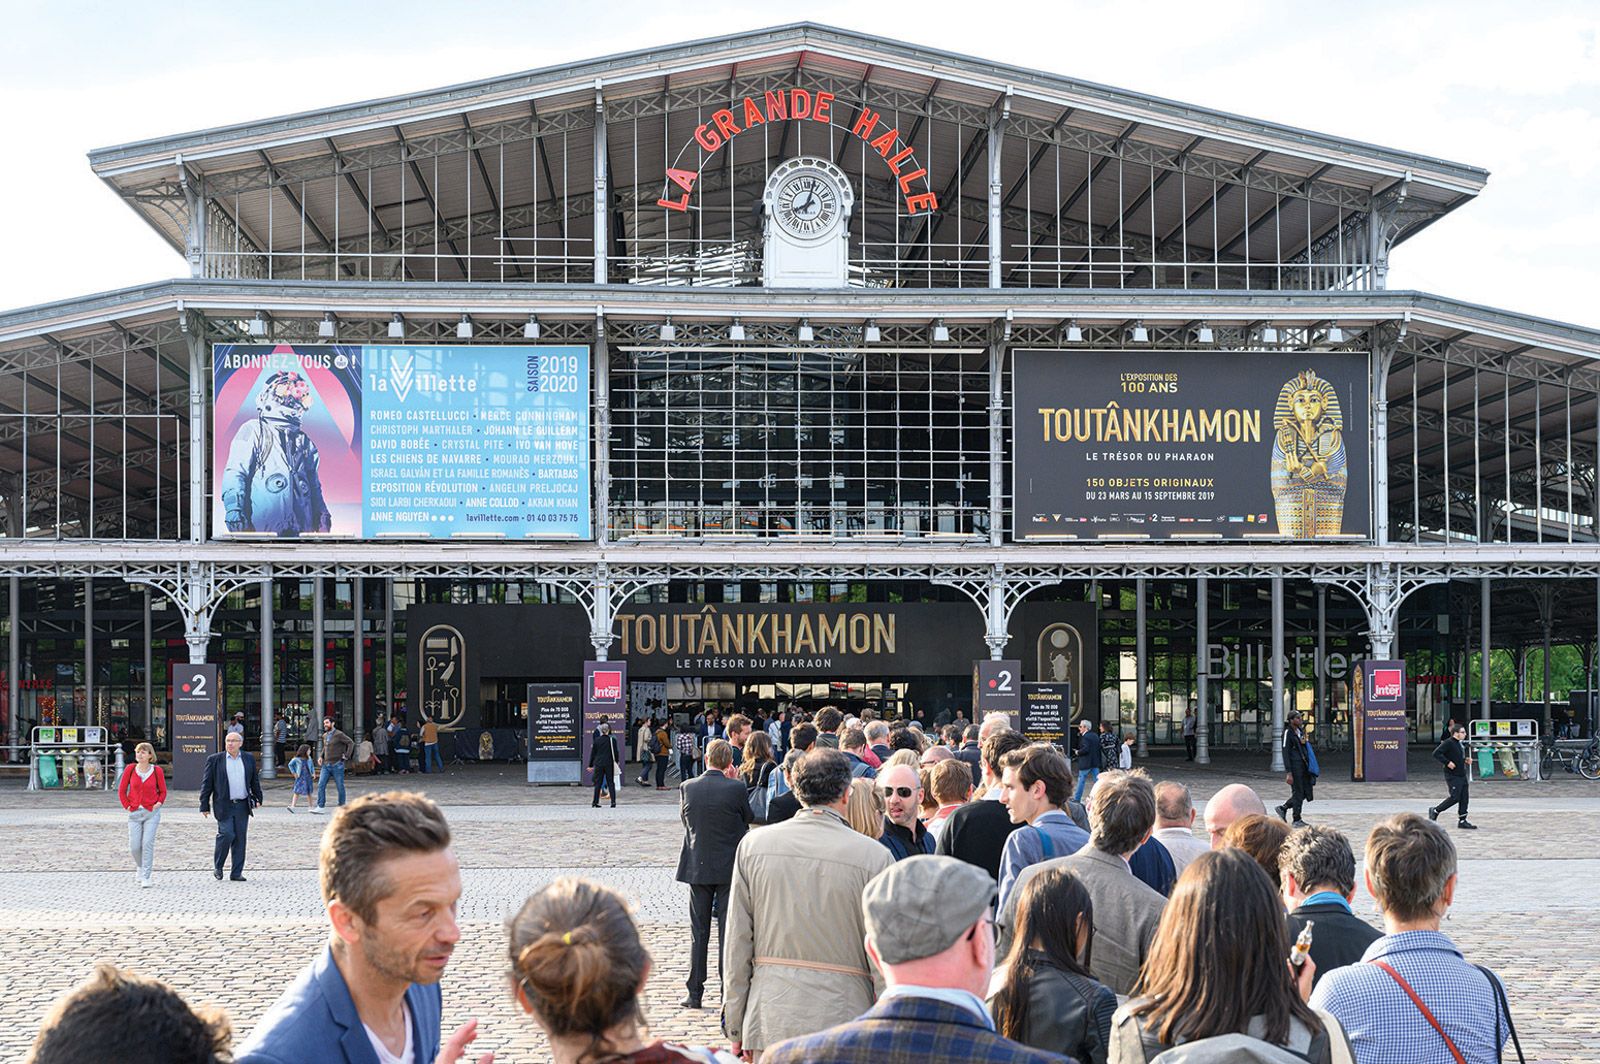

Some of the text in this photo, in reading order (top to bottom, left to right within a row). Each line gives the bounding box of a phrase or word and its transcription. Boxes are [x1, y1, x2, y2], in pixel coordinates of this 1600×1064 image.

[657, 88, 938, 214] LA GRANDE HALLE
[224, 354, 330, 368] ABONNEZ-VOUS
[540, 356, 578, 373] 2019
[527, 355, 538, 392] SAISON
[1120, 373, 1178, 381] L'EXPOSITION DES
[369, 374, 387, 392] la
[540, 375, 578, 392] 2020
[1121, 382, 1178, 393] 100 ANS
[370, 410, 578, 420] ROMEO CASTELLUCCI MERCE CUNNINGHAM
[1038, 401, 1260, 442] TOUTÂNKHAMON
[370, 425, 578, 435] CHRISTOPH MARTHALER JOHANN LE GUILLERM
[370, 437, 578, 450] DAVID BOBÉE CRYSTAL PITE IVO VAN HOVE
[370, 454, 578, 464] LES CHIENS DE NAVARRE MOURAD MERZOUKI
[1103, 451, 1143, 460] TRÉSOR
[371, 466, 578, 478] ISRAEL GALVÁN ET LA FAMILLE ROMANÈS BARTABAS
[371, 481, 578, 492] EXPOSITION RÉVOLUTION ANGELIN PRELJOCAJ
[1086, 492, 1214, 500] DU 23 MARS AU 15 SEPTEMBRE 2019
[370, 498, 386, 507] SIDI
[388, 498, 411, 507] LARBI
[414, 498, 456, 507] CHERKAOUI
[466, 498, 487, 507] ANNE
[527, 498, 554, 507] AKRAM
[556, 498, 578, 507] KHAN
[371, 512, 429, 521] ANNE NGUYEN
[1152, 514, 1158, 522] 2
[615, 604, 896, 655] TOUTÂNKHAMON
[676, 657, 832, 668] LE TRÉSOR DU PHARAON
[1207, 644, 1372, 679] Billtte
[192, 674, 207, 696] 2
[998, 670, 1012, 691] 2
